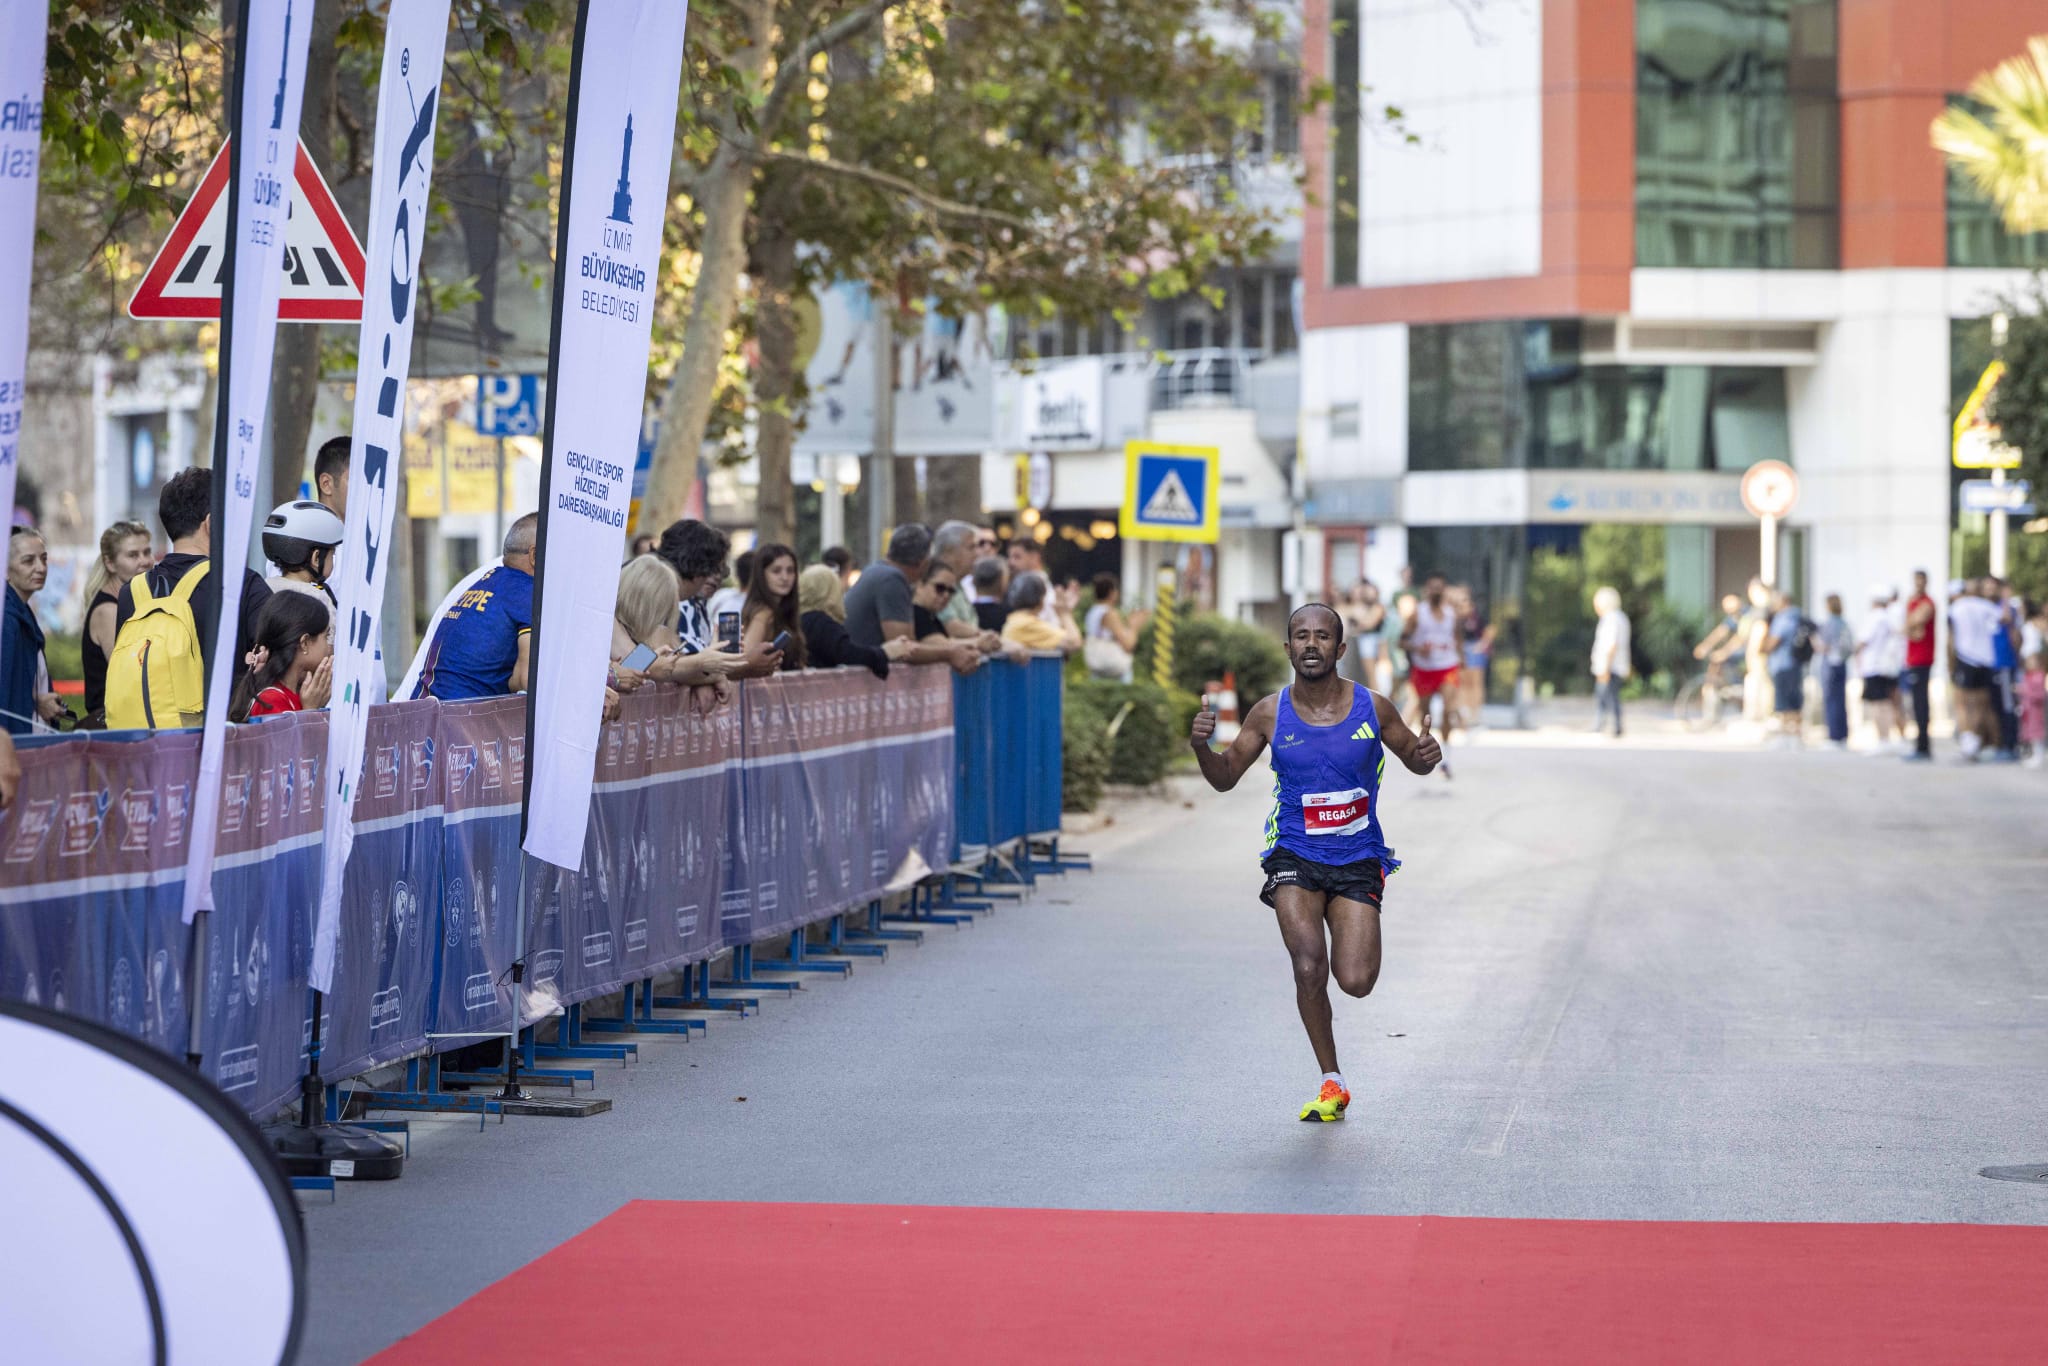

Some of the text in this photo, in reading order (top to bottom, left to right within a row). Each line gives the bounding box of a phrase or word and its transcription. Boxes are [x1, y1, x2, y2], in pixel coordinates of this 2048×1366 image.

[603, 223, 632, 253] İZMİR
[581, 251, 646, 292] BÜYÜKŞEHİR
[581, 290, 640, 323] BELEDİYESİ
[603, 462, 624, 483] SPOR
[1318, 805, 1357, 822] REGASA
